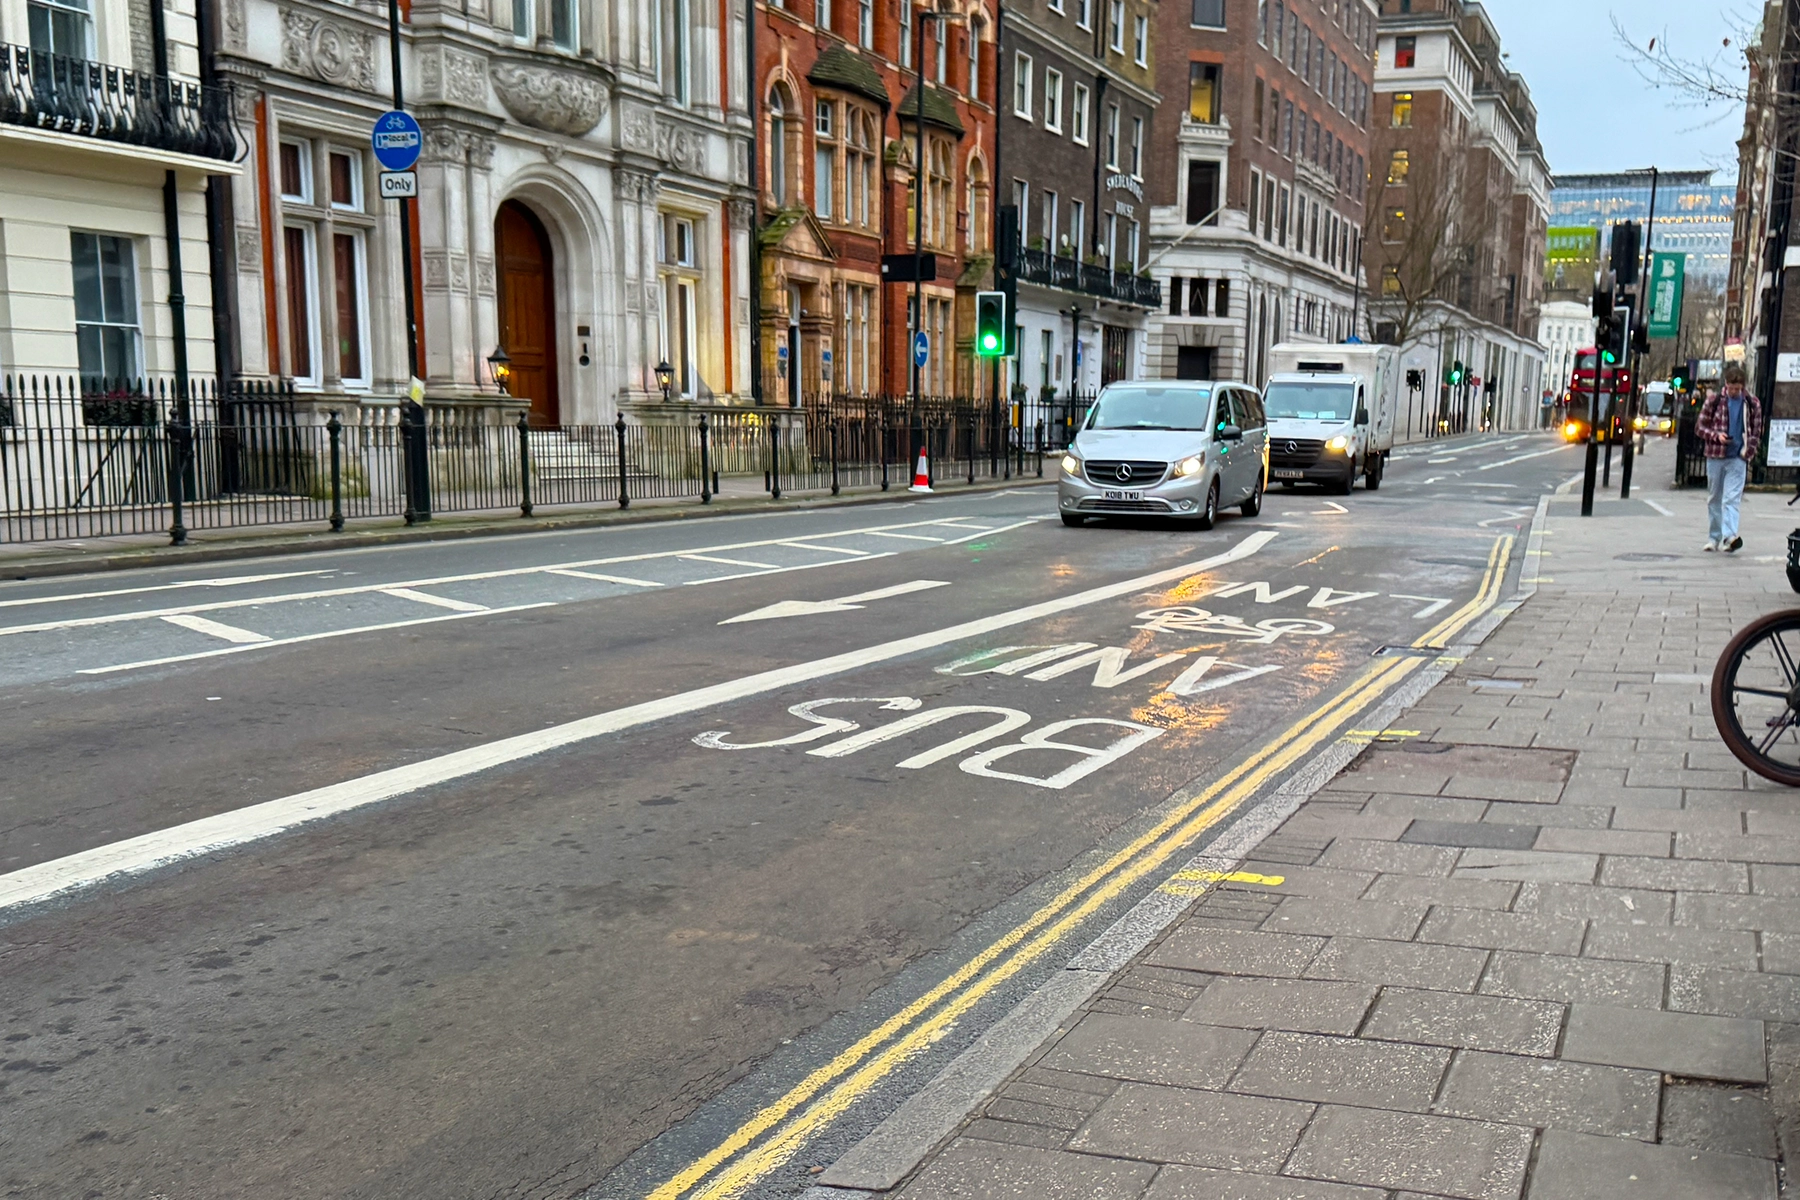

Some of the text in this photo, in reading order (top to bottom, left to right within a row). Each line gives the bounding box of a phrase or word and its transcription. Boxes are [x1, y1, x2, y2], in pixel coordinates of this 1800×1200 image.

[385, 178, 411, 192] Only
[1124, 491, 1140, 500] TWU
[933, 642, 1285, 695] AND
[691, 696, 1166, 790] BUS
